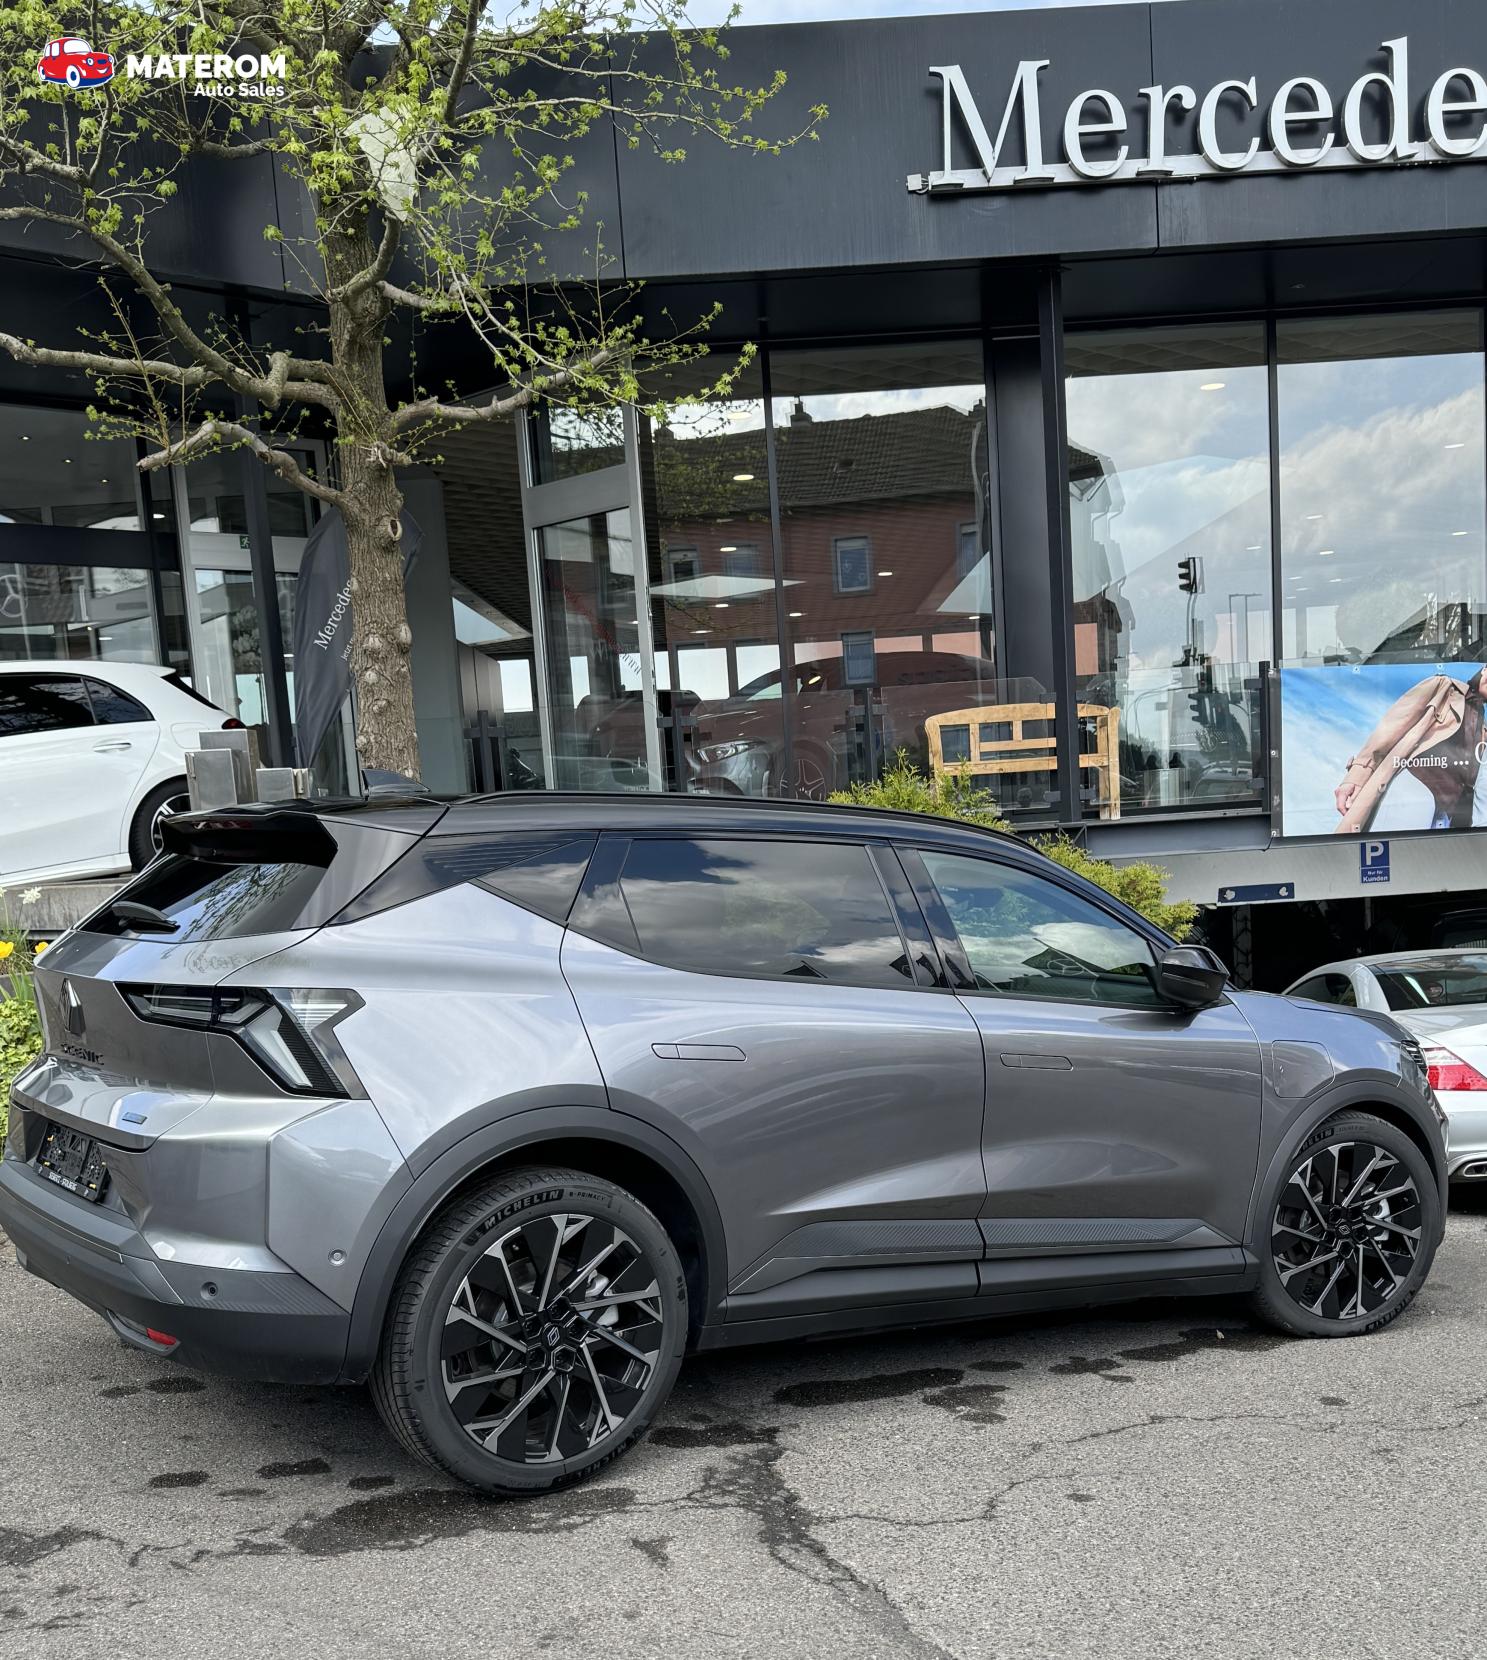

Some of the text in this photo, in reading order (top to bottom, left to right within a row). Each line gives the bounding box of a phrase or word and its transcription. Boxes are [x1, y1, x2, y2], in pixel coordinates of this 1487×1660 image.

[929, 36, 1487, 188] Mercede
[1393, 754, 1448, 768] Becoming
[1365, 842, 1384, 865] P
[484, 1190, 560, 1230] MICHELIN
